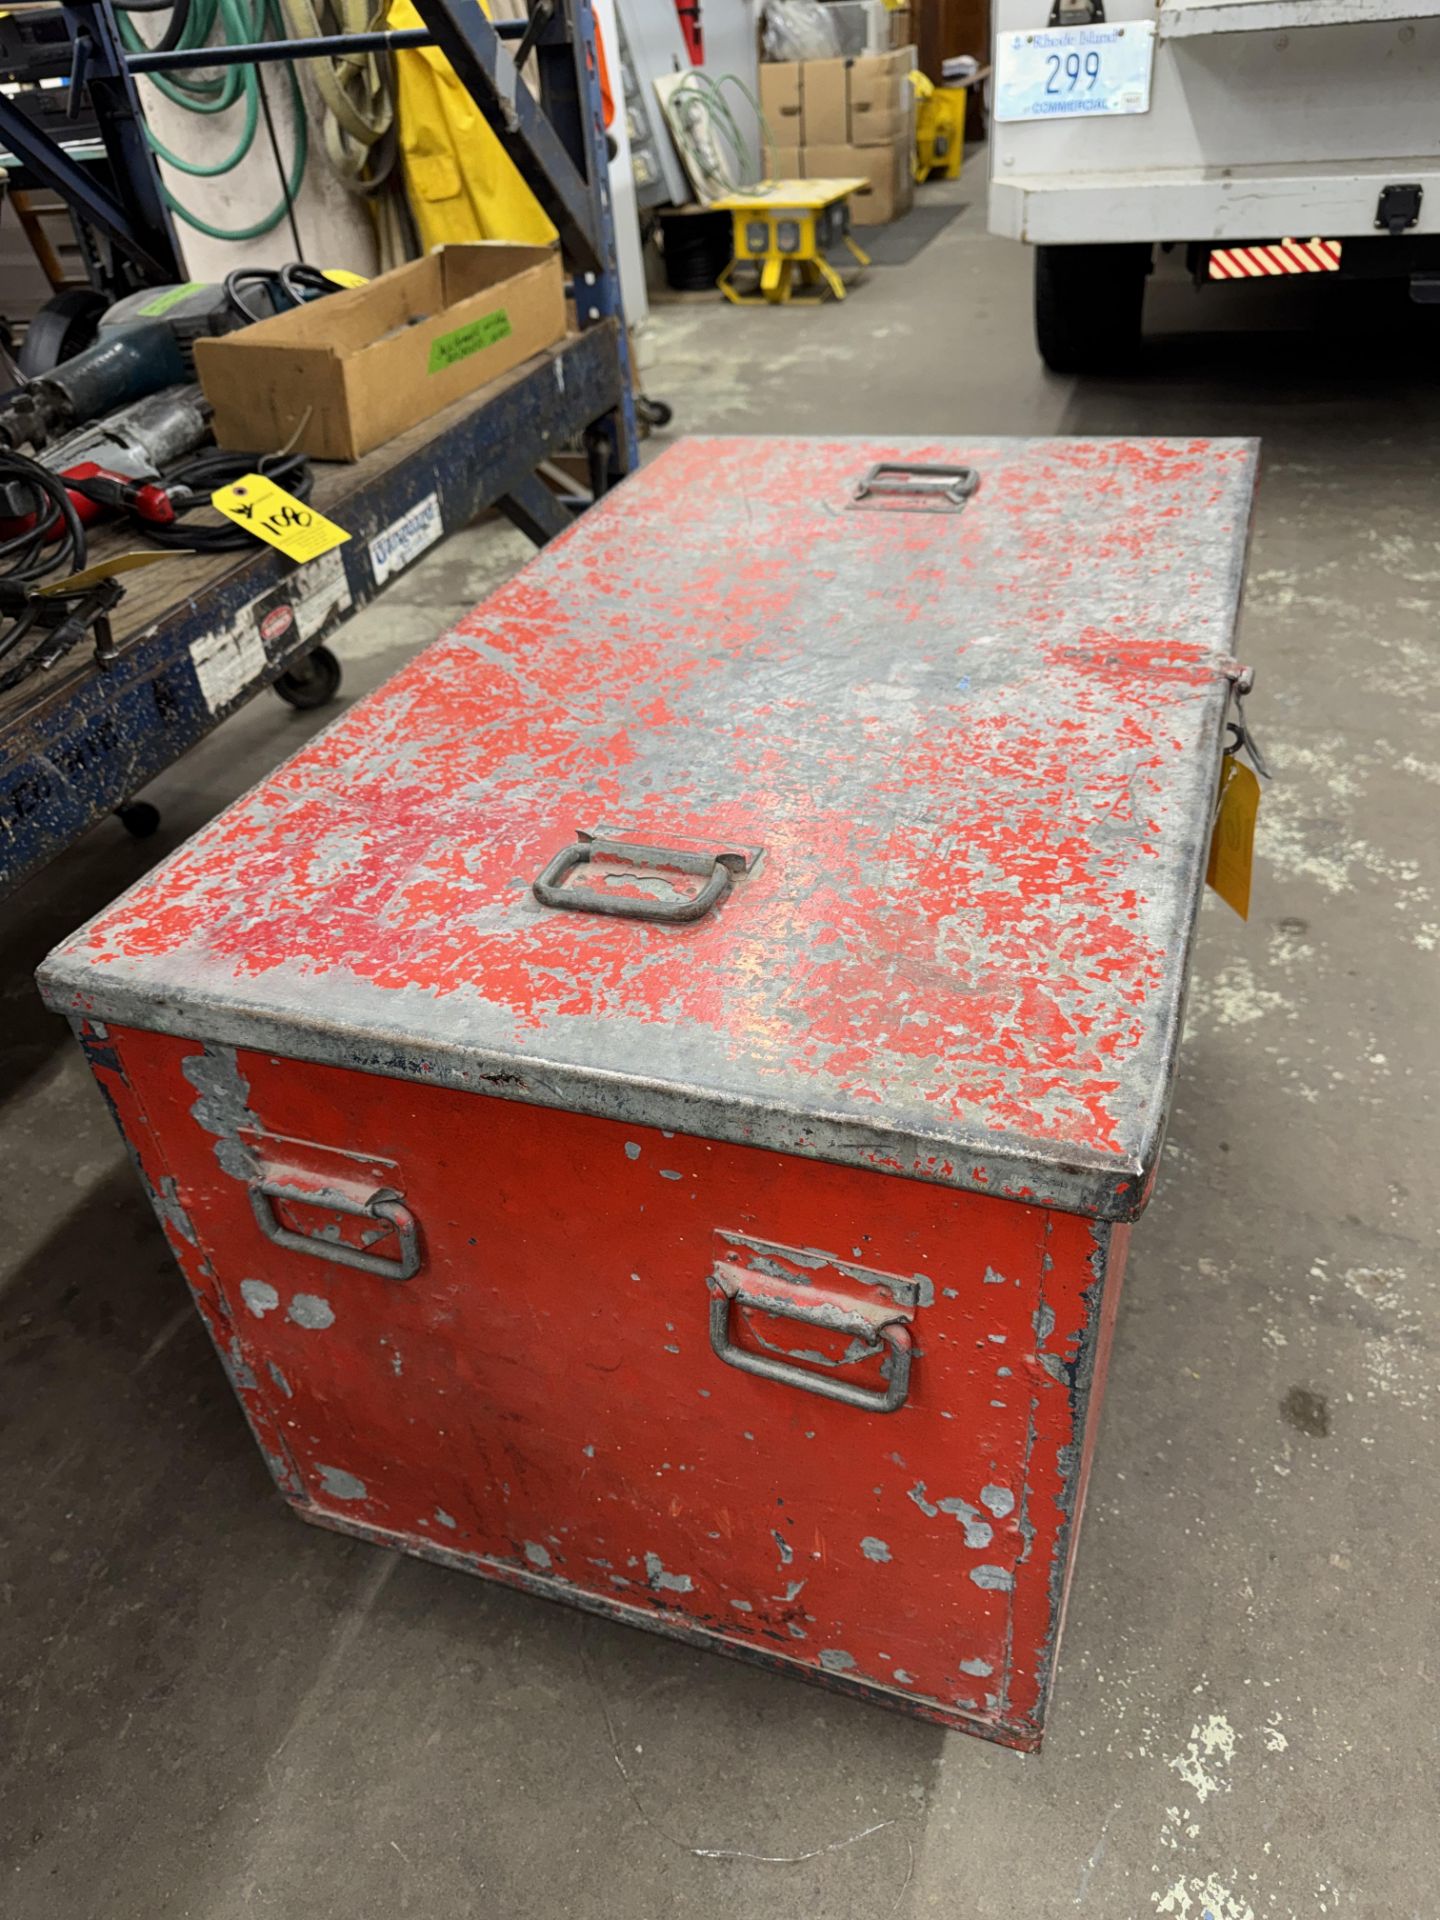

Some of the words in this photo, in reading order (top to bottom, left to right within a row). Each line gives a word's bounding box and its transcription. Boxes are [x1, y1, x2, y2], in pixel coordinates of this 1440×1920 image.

[1033, 33, 1074, 49] Rhode
[1079, 30, 1117, 45] Island
[1045, 51, 1100, 94] 299
